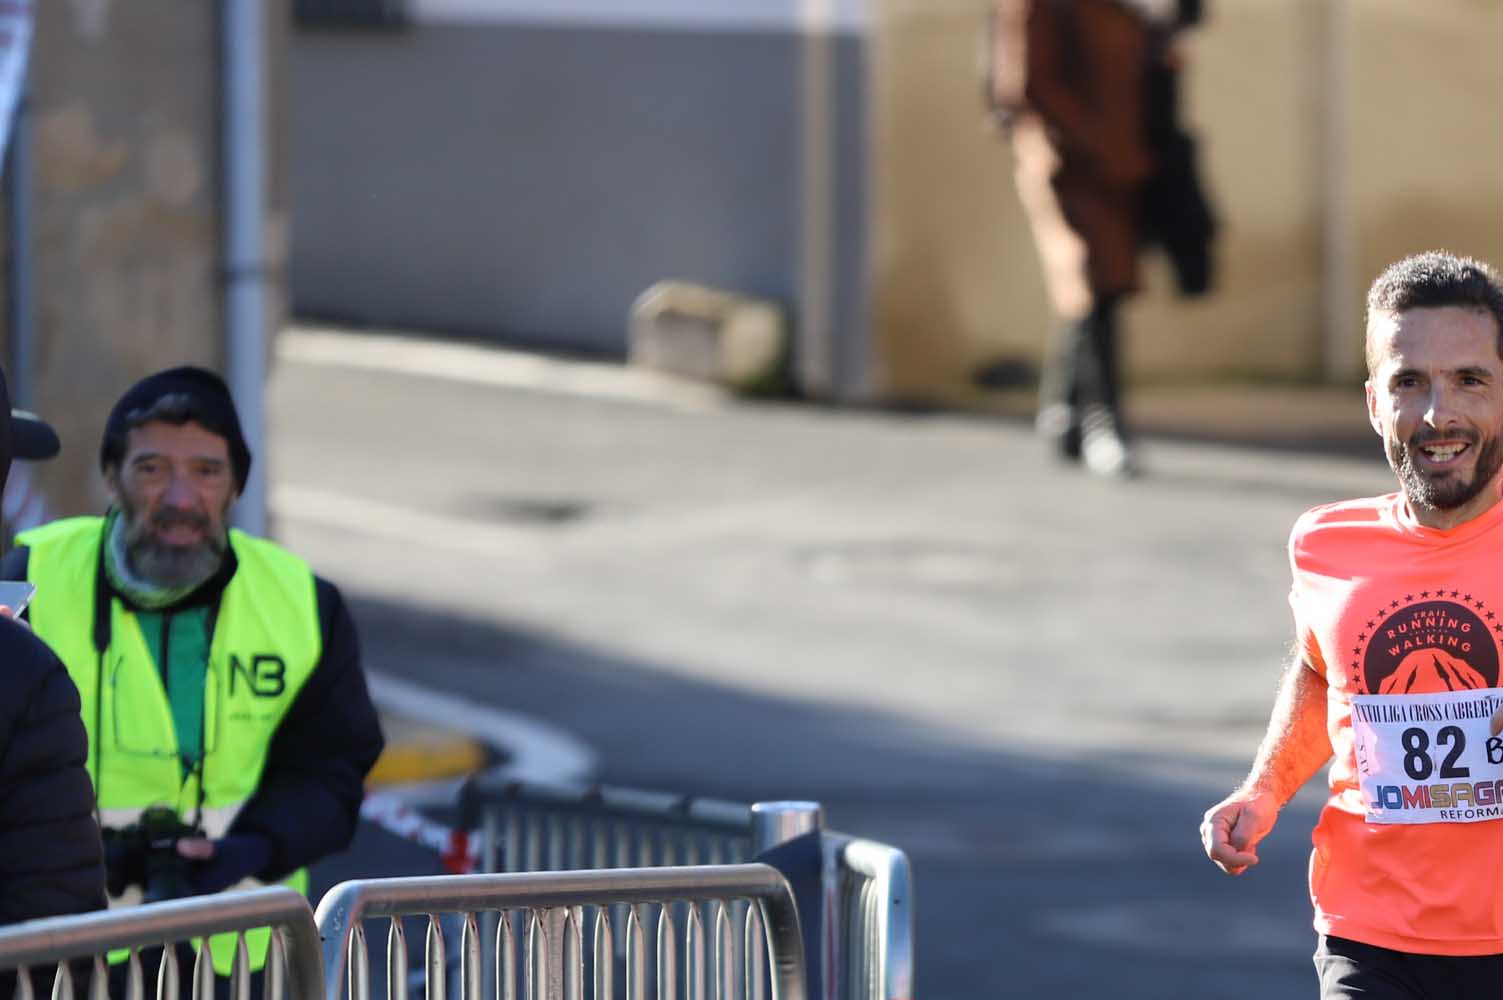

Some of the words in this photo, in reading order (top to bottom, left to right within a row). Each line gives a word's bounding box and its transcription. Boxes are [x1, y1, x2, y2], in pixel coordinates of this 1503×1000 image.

[1413, 609, 1446, 619] TRAIL
[1387, 617, 1472, 639] RUNNING
[1388, 634, 1472, 656] WALKING
[1383, 703, 1407, 723] LIGA
[1409, 703, 1443, 721] CROSS
[1401, 725, 1470, 781] 82
